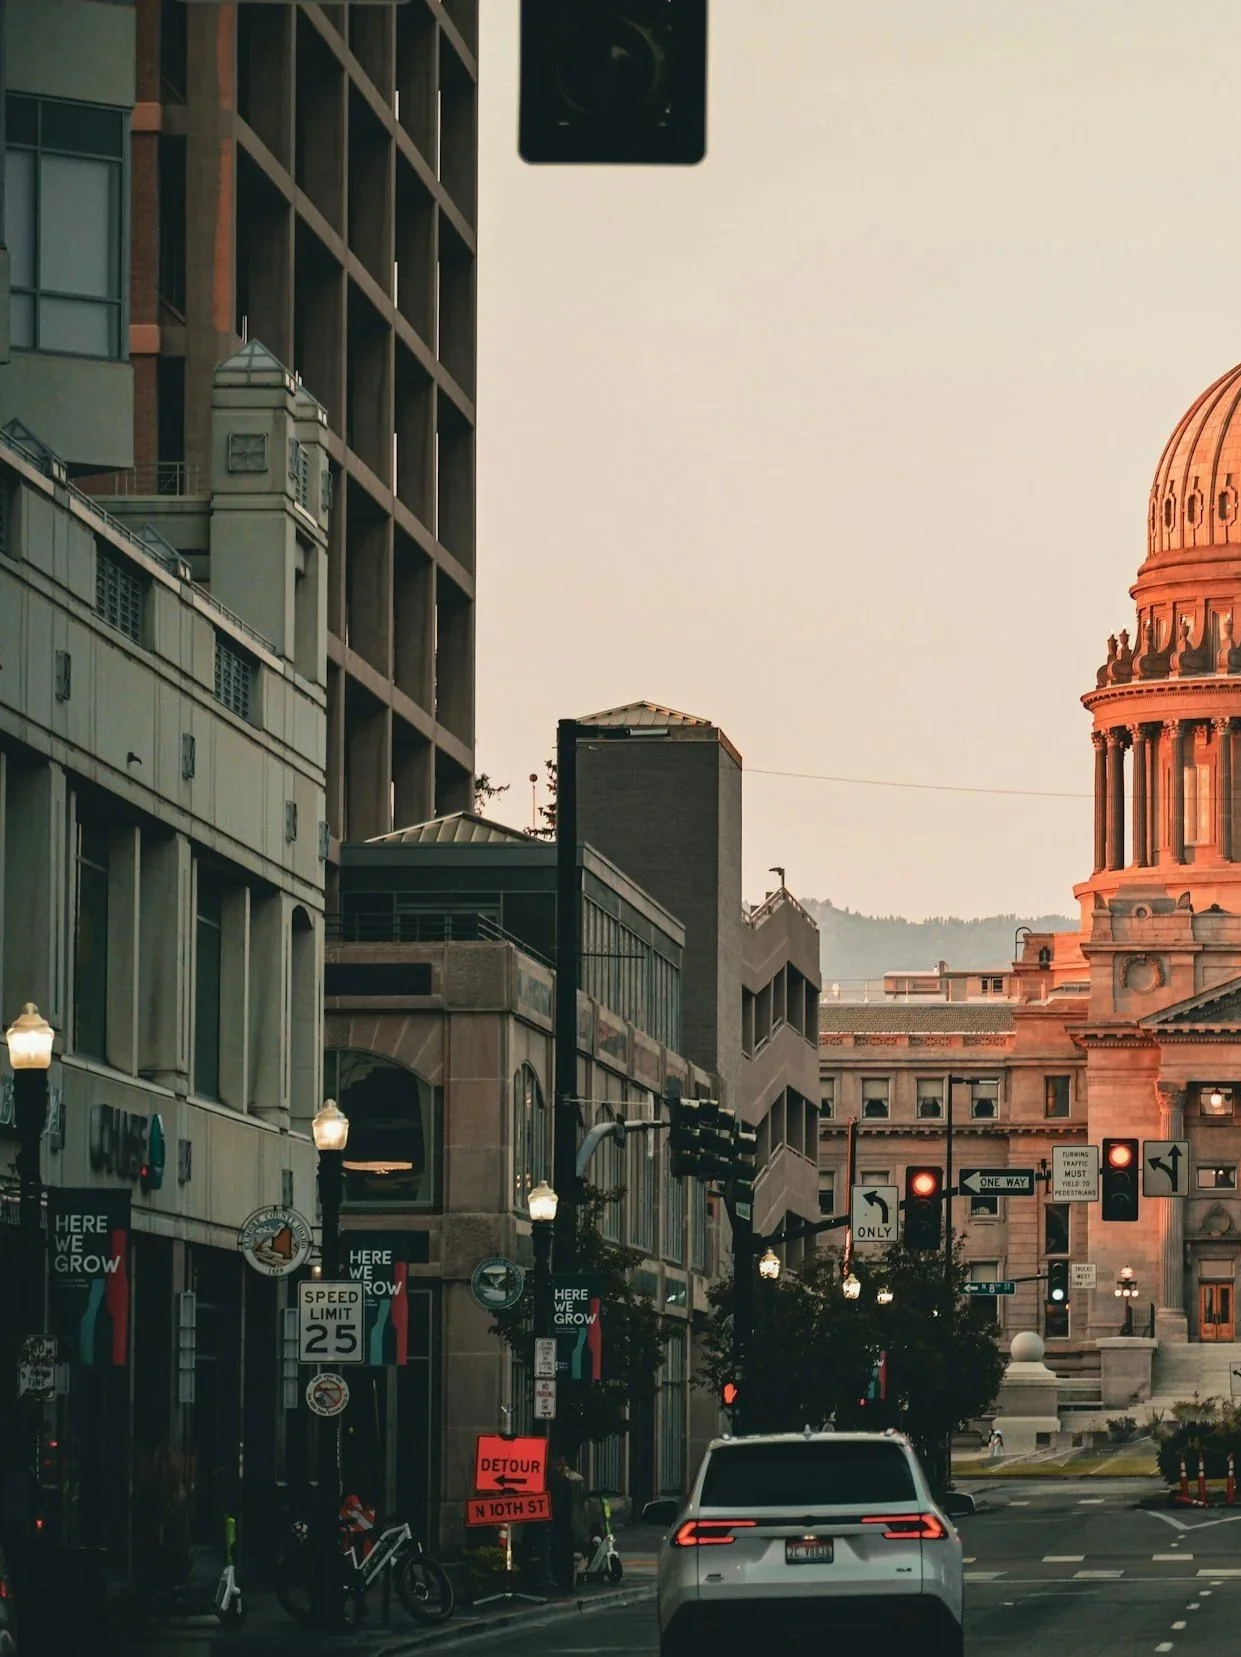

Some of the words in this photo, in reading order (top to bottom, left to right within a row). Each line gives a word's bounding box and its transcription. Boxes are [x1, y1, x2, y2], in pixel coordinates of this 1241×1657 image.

[1065, 1170, 1086, 1178] MUST
[980, 1177, 1000, 1187] ONE
[1006, 1177, 1027, 1187] WAY
[55, 1214, 108, 1233] HERE
[264, 1211, 295, 1224] COUNTY
[857, 1227, 892, 1239] ONLY
[54, 1235, 84, 1253] WE
[54, 1255, 121, 1273] GROW
[350, 1250, 392, 1265] HERE
[350, 1266, 373, 1280] WE
[363, 1281, 402, 1297] ROW
[554, 1289, 589, 1300] HERE
[304, 1291, 359, 1304] SPEED
[553, 1301, 574, 1312] WE
[310, 1308, 352, 1320] LIMIT
[554, 1313, 596, 1325] GROW
[305, 1324, 358, 1353] 25
[481, 1458, 540, 1473] DETOUR
[475, 1504, 485, 1518] N
[490, 1501, 523, 1517] 10TH
[528, 1500, 545, 1513] ST
